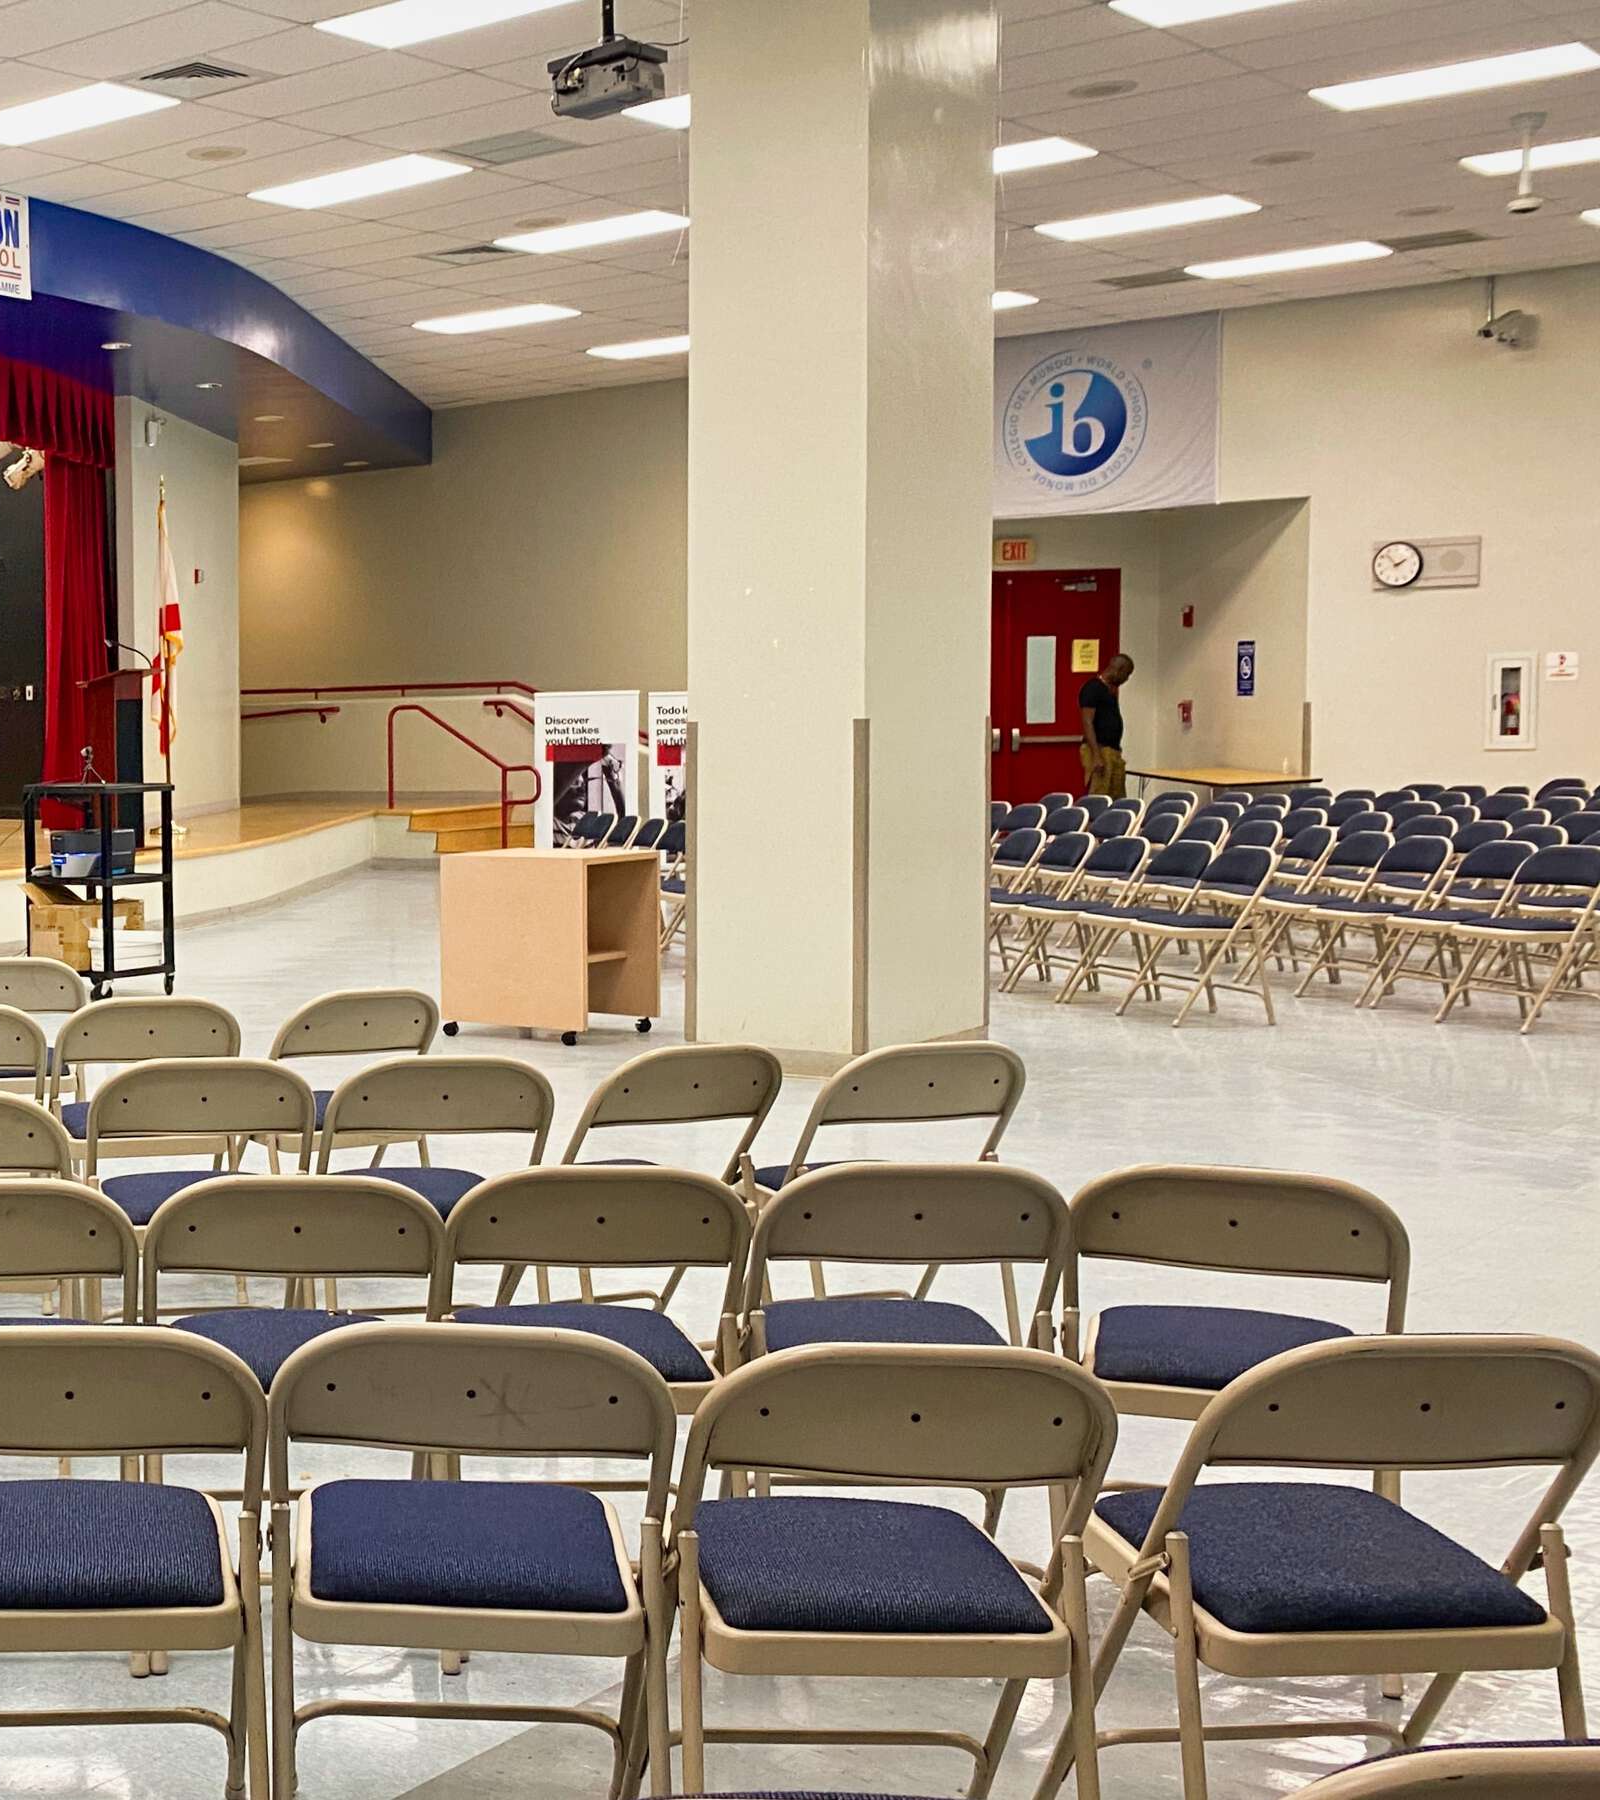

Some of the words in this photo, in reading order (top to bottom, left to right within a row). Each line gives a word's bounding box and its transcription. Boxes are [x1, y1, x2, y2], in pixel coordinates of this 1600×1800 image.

[1029, 355, 1073, 387] MUNDO
[1086, 355, 1126, 381] WORLD
[1125, 379, 1143, 431] SCHOOL
[1032, 472, 1074, 491] MONDE
[1002, 542, 1028, 561] EXIT
[656, 706, 681, 715] Todo
[545, 716, 590, 725] Discover
[545, 727, 570, 735] what
[572, 727, 600, 735] takes
[656, 728, 679, 737] para
